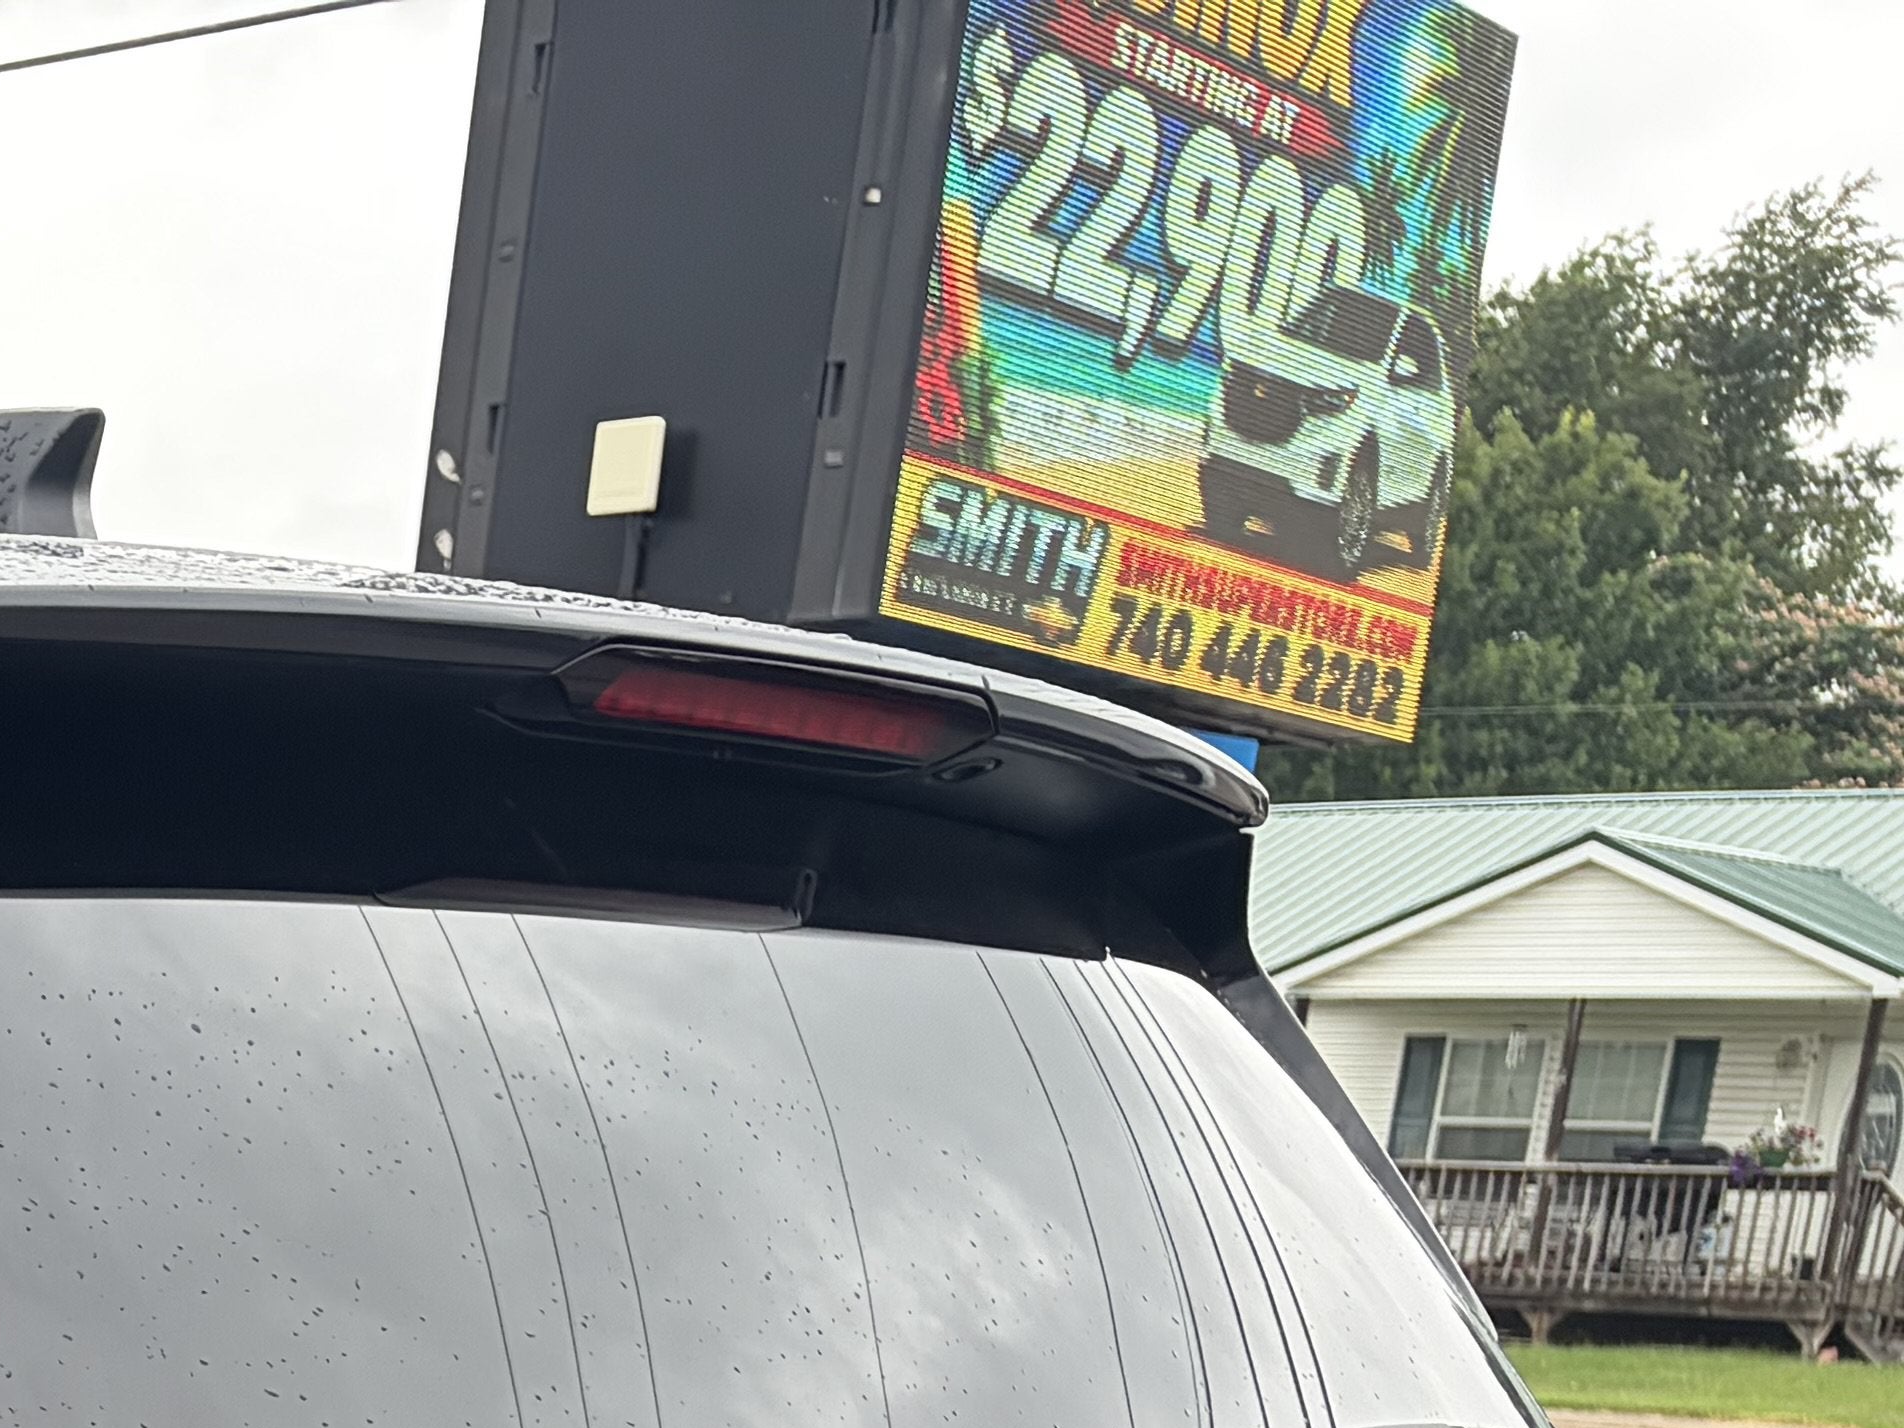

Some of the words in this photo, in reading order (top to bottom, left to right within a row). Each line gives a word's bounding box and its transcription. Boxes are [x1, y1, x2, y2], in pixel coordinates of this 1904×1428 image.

[1109, 22, 1260, 128] STARTING
[1258, 95, 1301, 145] AT
[963, 25, 1366, 362] $22,900
[910, 480, 1107, 598] SMITH
[1107, 596, 1192, 671] 740
[1200, 620, 1288, 695] 446
[1293, 643, 1405, 725] 2282
